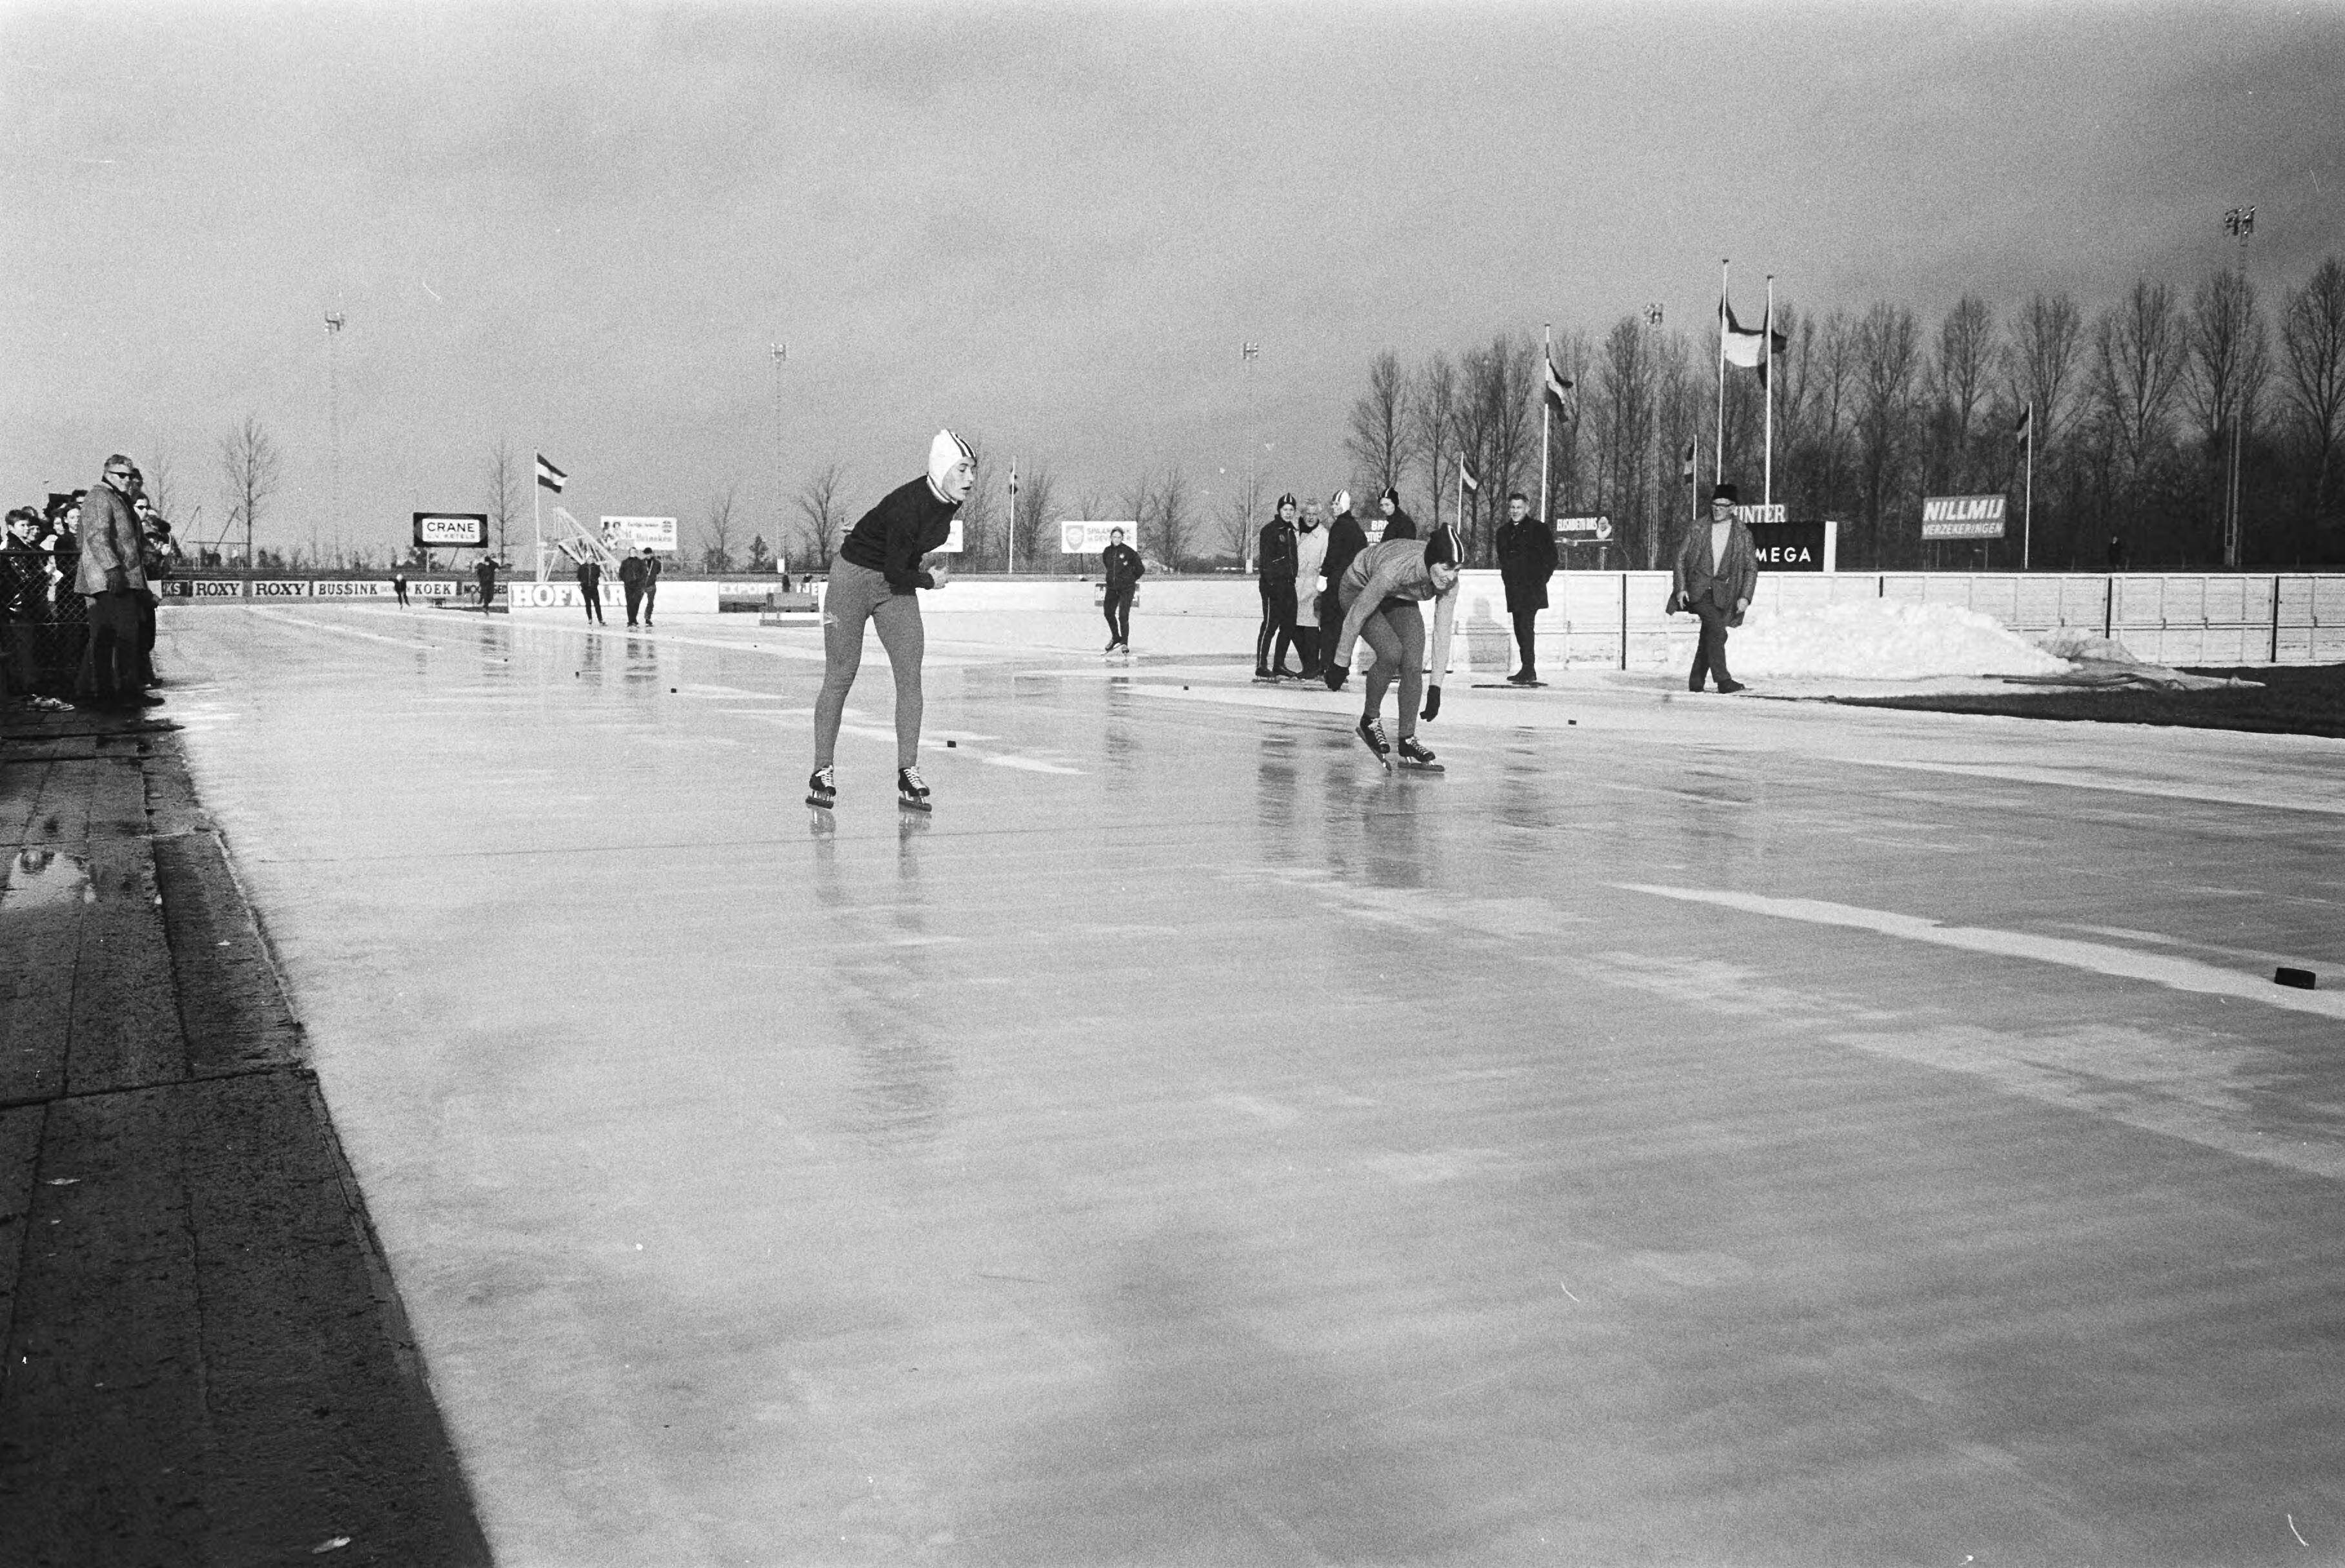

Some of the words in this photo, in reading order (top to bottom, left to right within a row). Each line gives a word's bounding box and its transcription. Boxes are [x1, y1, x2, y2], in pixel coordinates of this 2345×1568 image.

[1924, 499, 2004, 520] NILLMIJ
[427, 522, 475, 533] CRANE
[1924, 523, 2004, 535] VERZEKERINGEN
[1755, 547, 1812, 563] MEGA
[196, 583, 240, 596] ROXY
[255, 583, 305, 596] ROXY
[318, 584, 378, 595] BUSSINK
[414, 584, 451, 595] KOEK
[720, 582, 778, 595] EXPORT
